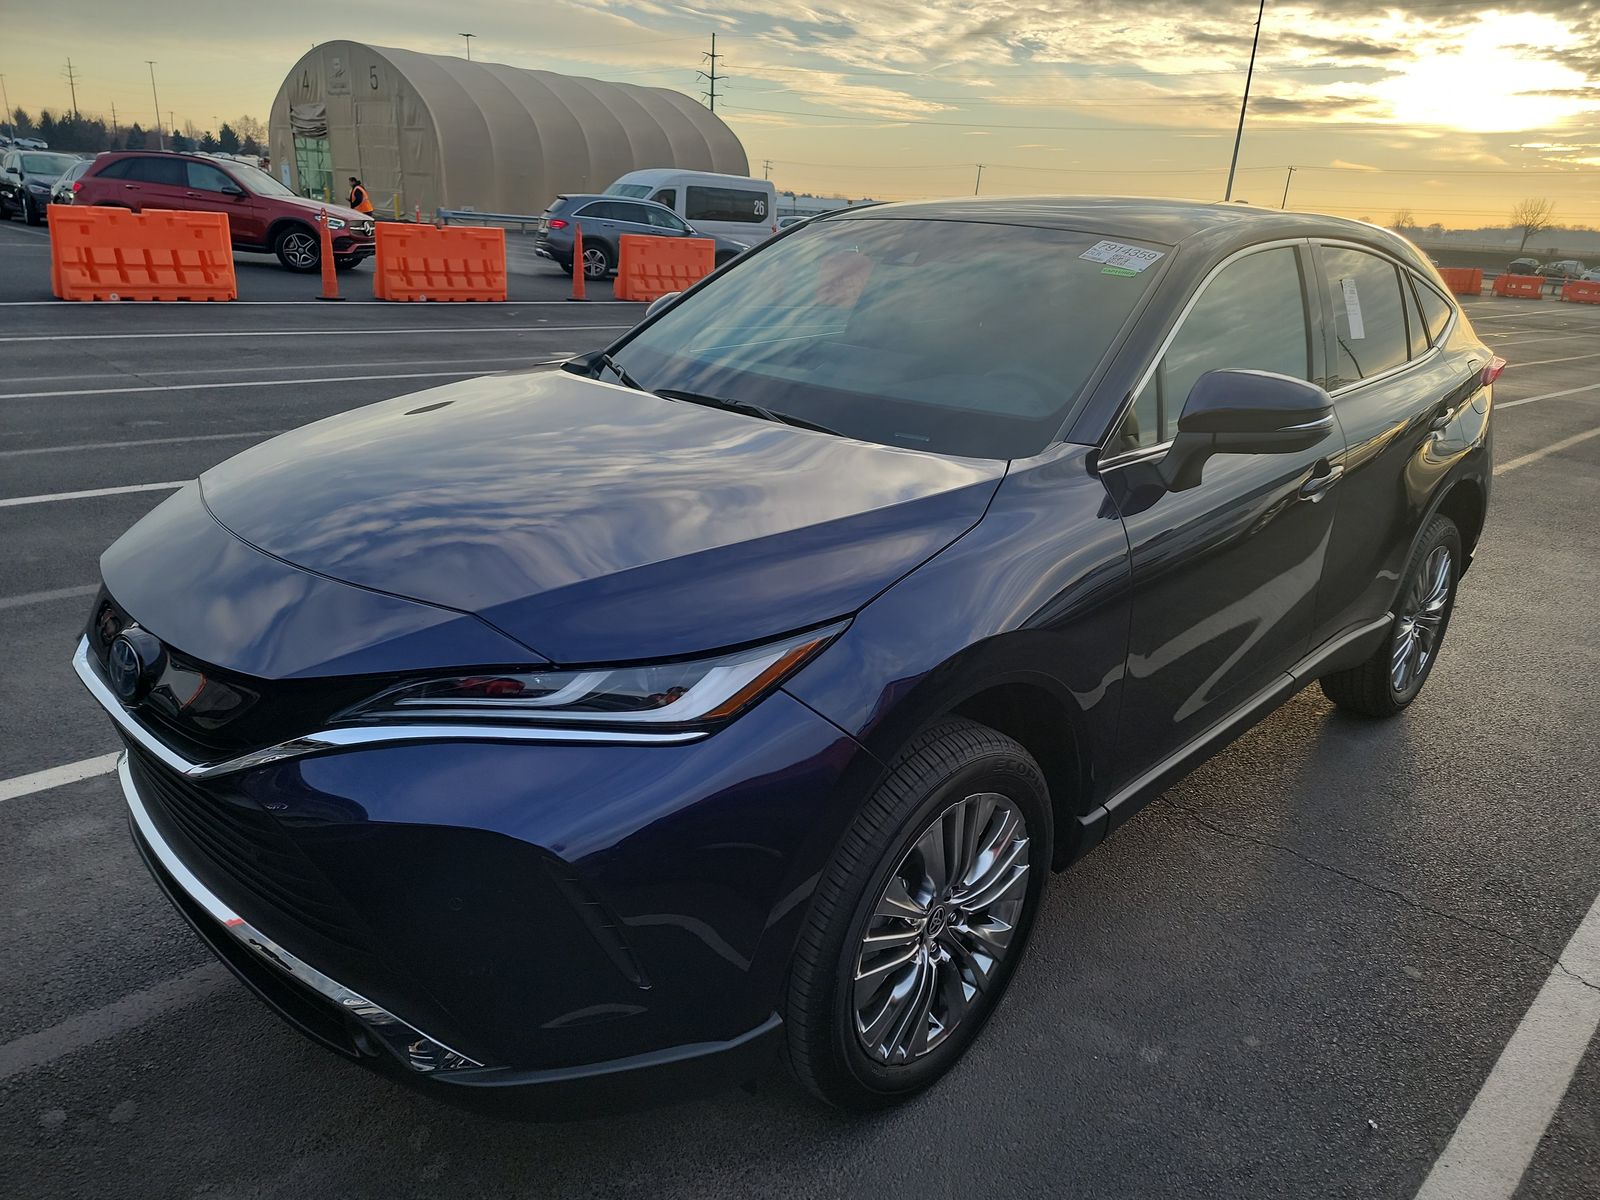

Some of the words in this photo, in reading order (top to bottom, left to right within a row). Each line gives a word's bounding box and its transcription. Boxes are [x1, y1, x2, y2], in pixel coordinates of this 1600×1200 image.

[302, 70, 310, 88] 4
[369, 65, 379, 90] 5
[754, 200, 765, 215] 26
[1099, 243, 1157, 260] 7914359
